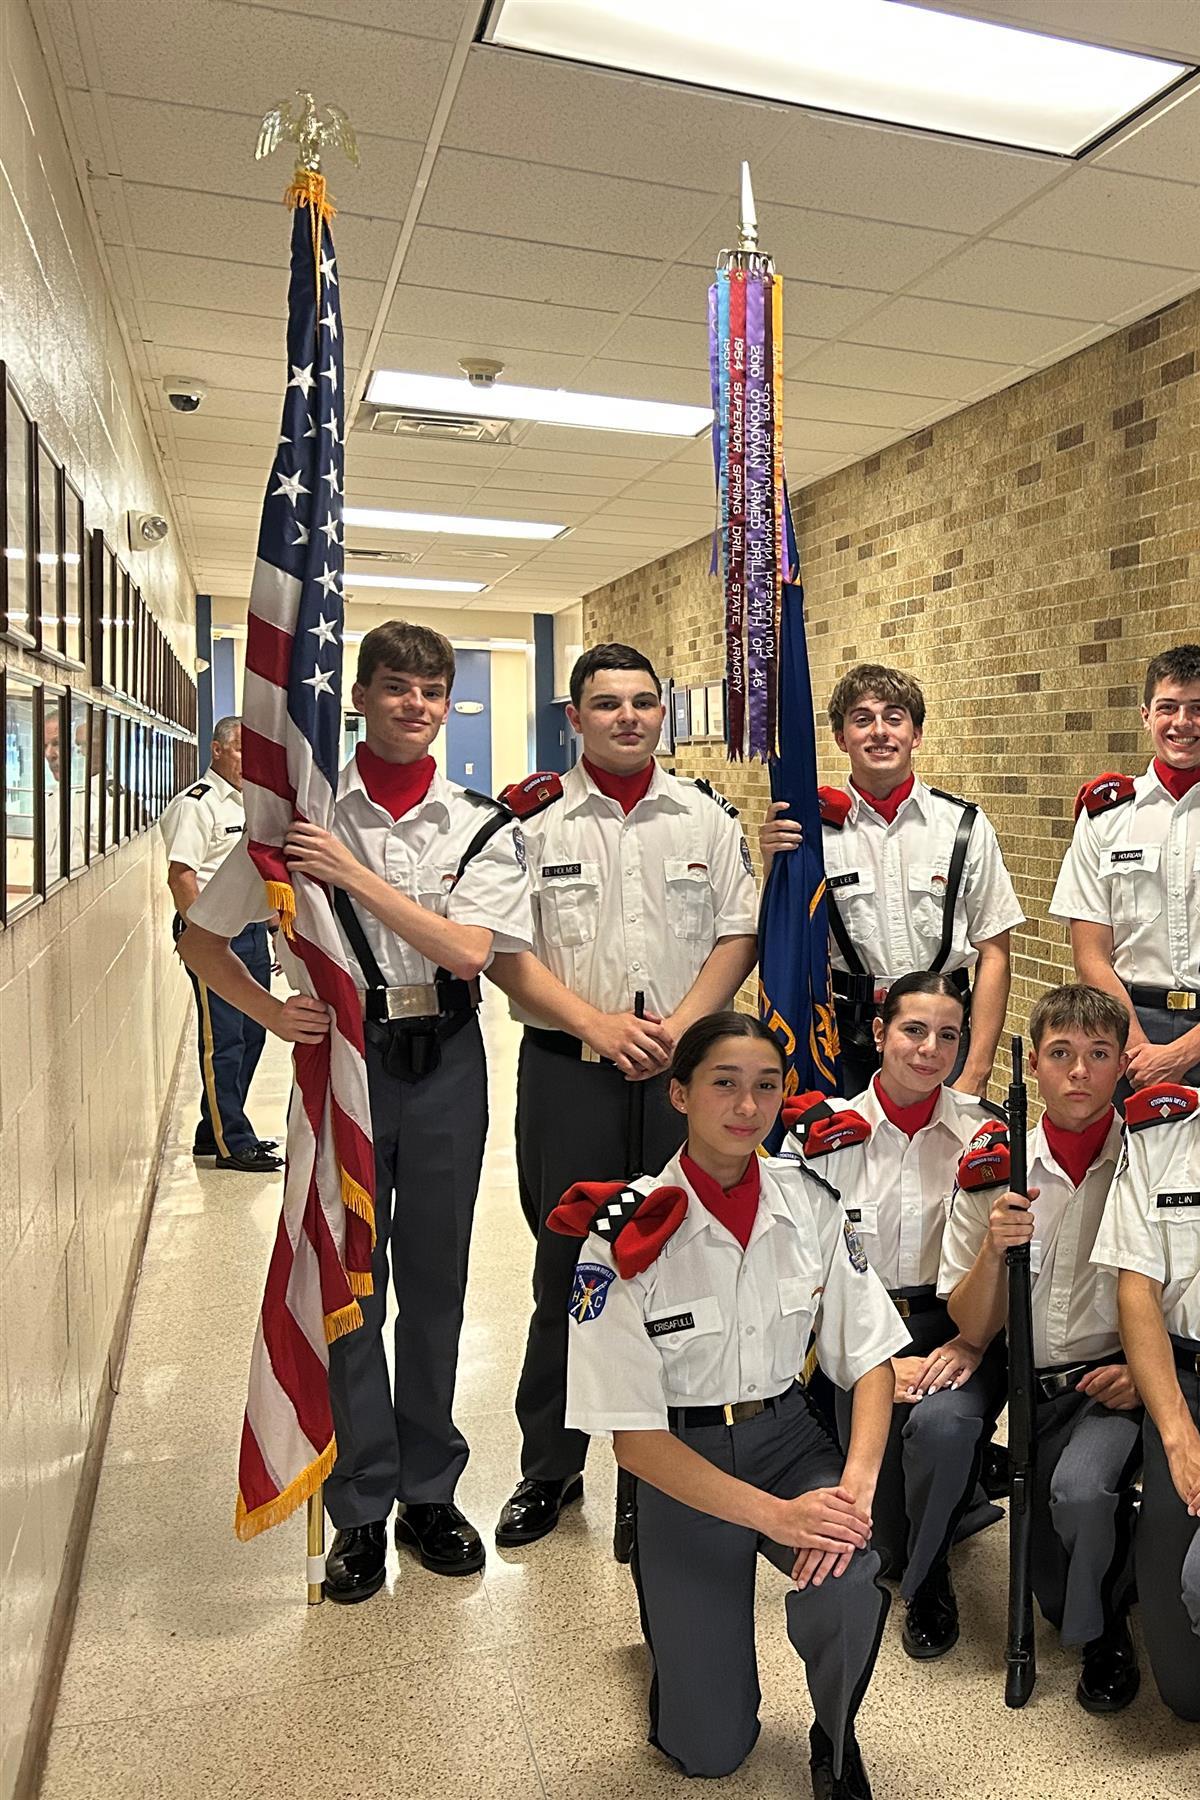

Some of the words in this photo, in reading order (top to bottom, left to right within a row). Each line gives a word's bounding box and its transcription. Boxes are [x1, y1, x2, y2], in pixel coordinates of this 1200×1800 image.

[733, 337, 744, 370] 1954
[750, 345, 760, 378] 2010
[733, 382, 743, 453] SUPERIOR
[750, 388, 760, 469] O'DONOVAN
[732, 464, 742, 514] SPRING
[750, 479, 761, 529] ARMED
[732, 525, 742, 567] DRILL
[751, 540, 762, 582] DRILL
[731, 583, 741, 625] STATE
[751, 598, 762, 626] 4TH
[751, 638, 762, 657] OF
[732, 636, 742, 694] ARMORY
[752, 668, 763, 688] 46
[554, 865, 579, 874] HOLMES
[839, 876, 853, 885] LEE
[1165, 1195, 1174, 1204] R.
[1178, 1195, 1193, 1204] LIN
[572, 1291, 580, 1302] H
[594, 1296, 603, 1308] C
[654, 1317, 692, 1332] CRISAFULLI
